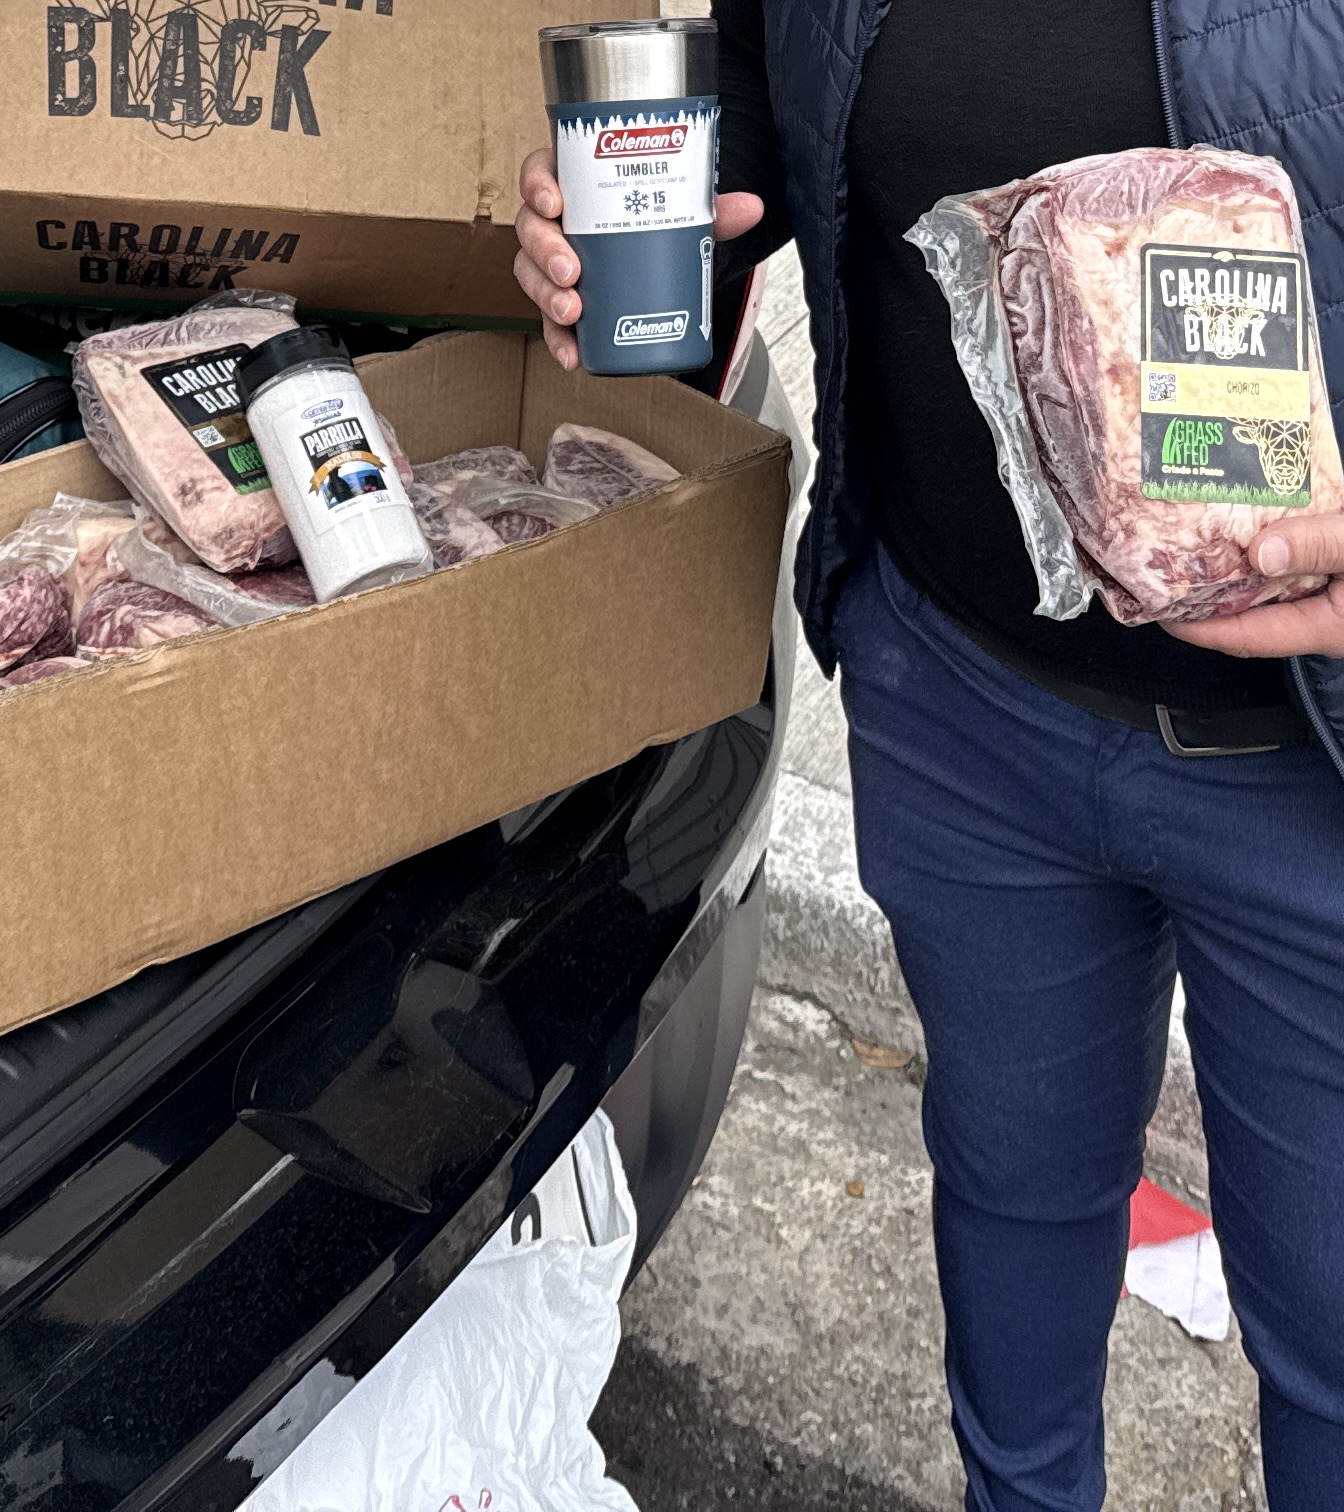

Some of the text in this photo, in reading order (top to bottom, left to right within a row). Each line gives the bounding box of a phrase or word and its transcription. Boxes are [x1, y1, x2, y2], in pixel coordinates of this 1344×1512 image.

[47, 6, 331, 136] BLACK
[600, 131, 670, 153] Coleman
[615, 161, 668, 177] TUMBLER
[652, 191, 666, 204] 15
[36, 219, 301, 264] CAROLINA
[79, 256, 249, 291] BLACK
[1159, 268, 1288, 315] CAROLINA
[621, 320, 673, 337] Coleman
[1183, 313, 1268, 356] BLACK
[1226, 380, 1260, 396] CHORIZO
[304, 420, 364, 456] PARRILLA
[1174, 420, 1224, 445] GRASS
[1183, 443, 1209, 466] FED
